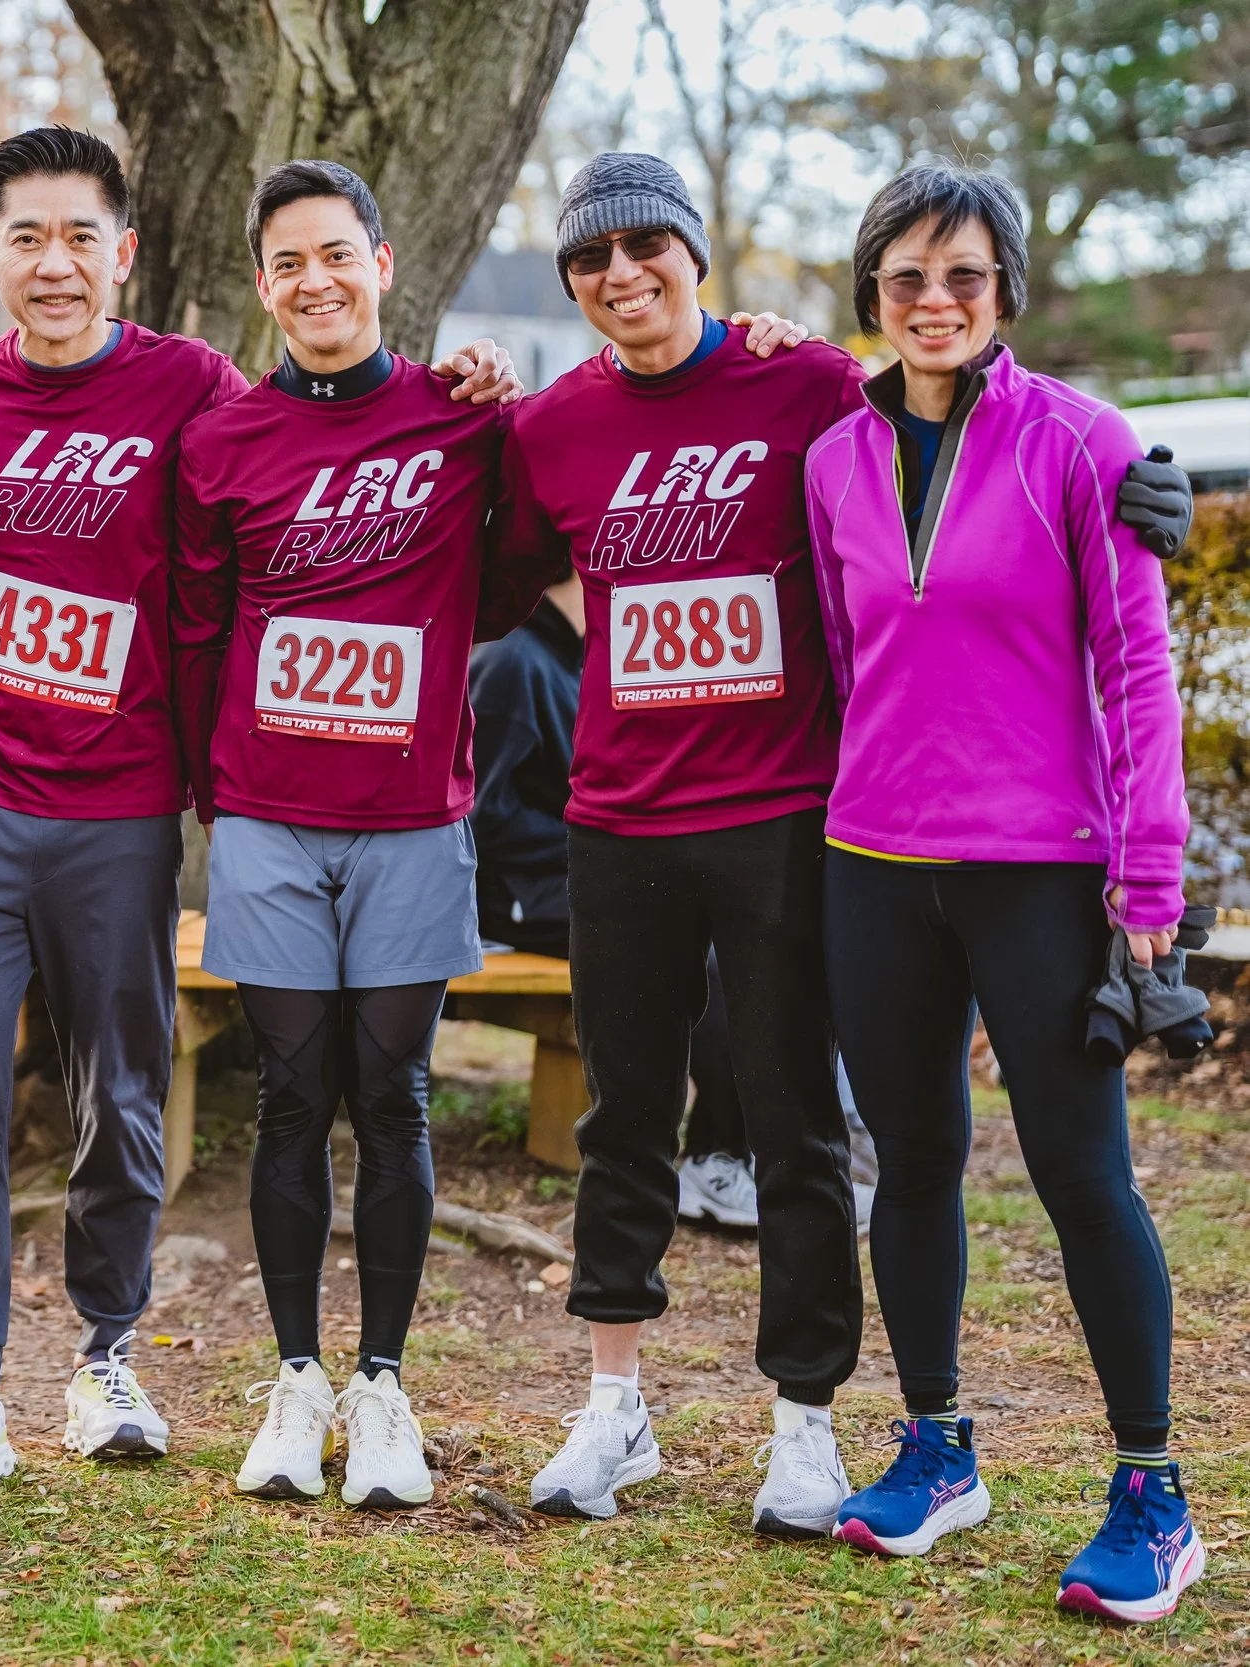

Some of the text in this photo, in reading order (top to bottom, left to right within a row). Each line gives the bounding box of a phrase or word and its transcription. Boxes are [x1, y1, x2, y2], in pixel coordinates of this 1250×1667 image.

[0, 429, 154, 486] LRC
[293, 449, 444, 522] LRC
[607, 440, 769, 510] LRC
[266, 507, 428, 575] RUN
[588, 501, 745, 571] RUN
[621, 592, 765, 675] 2889
[53, 687, 111, 708] TIMING
[269, 632, 406, 710] 3229
[616, 679, 777, 703] TRISTATE TIMING
[260, 712, 408, 738] TRISTATE TIMING
